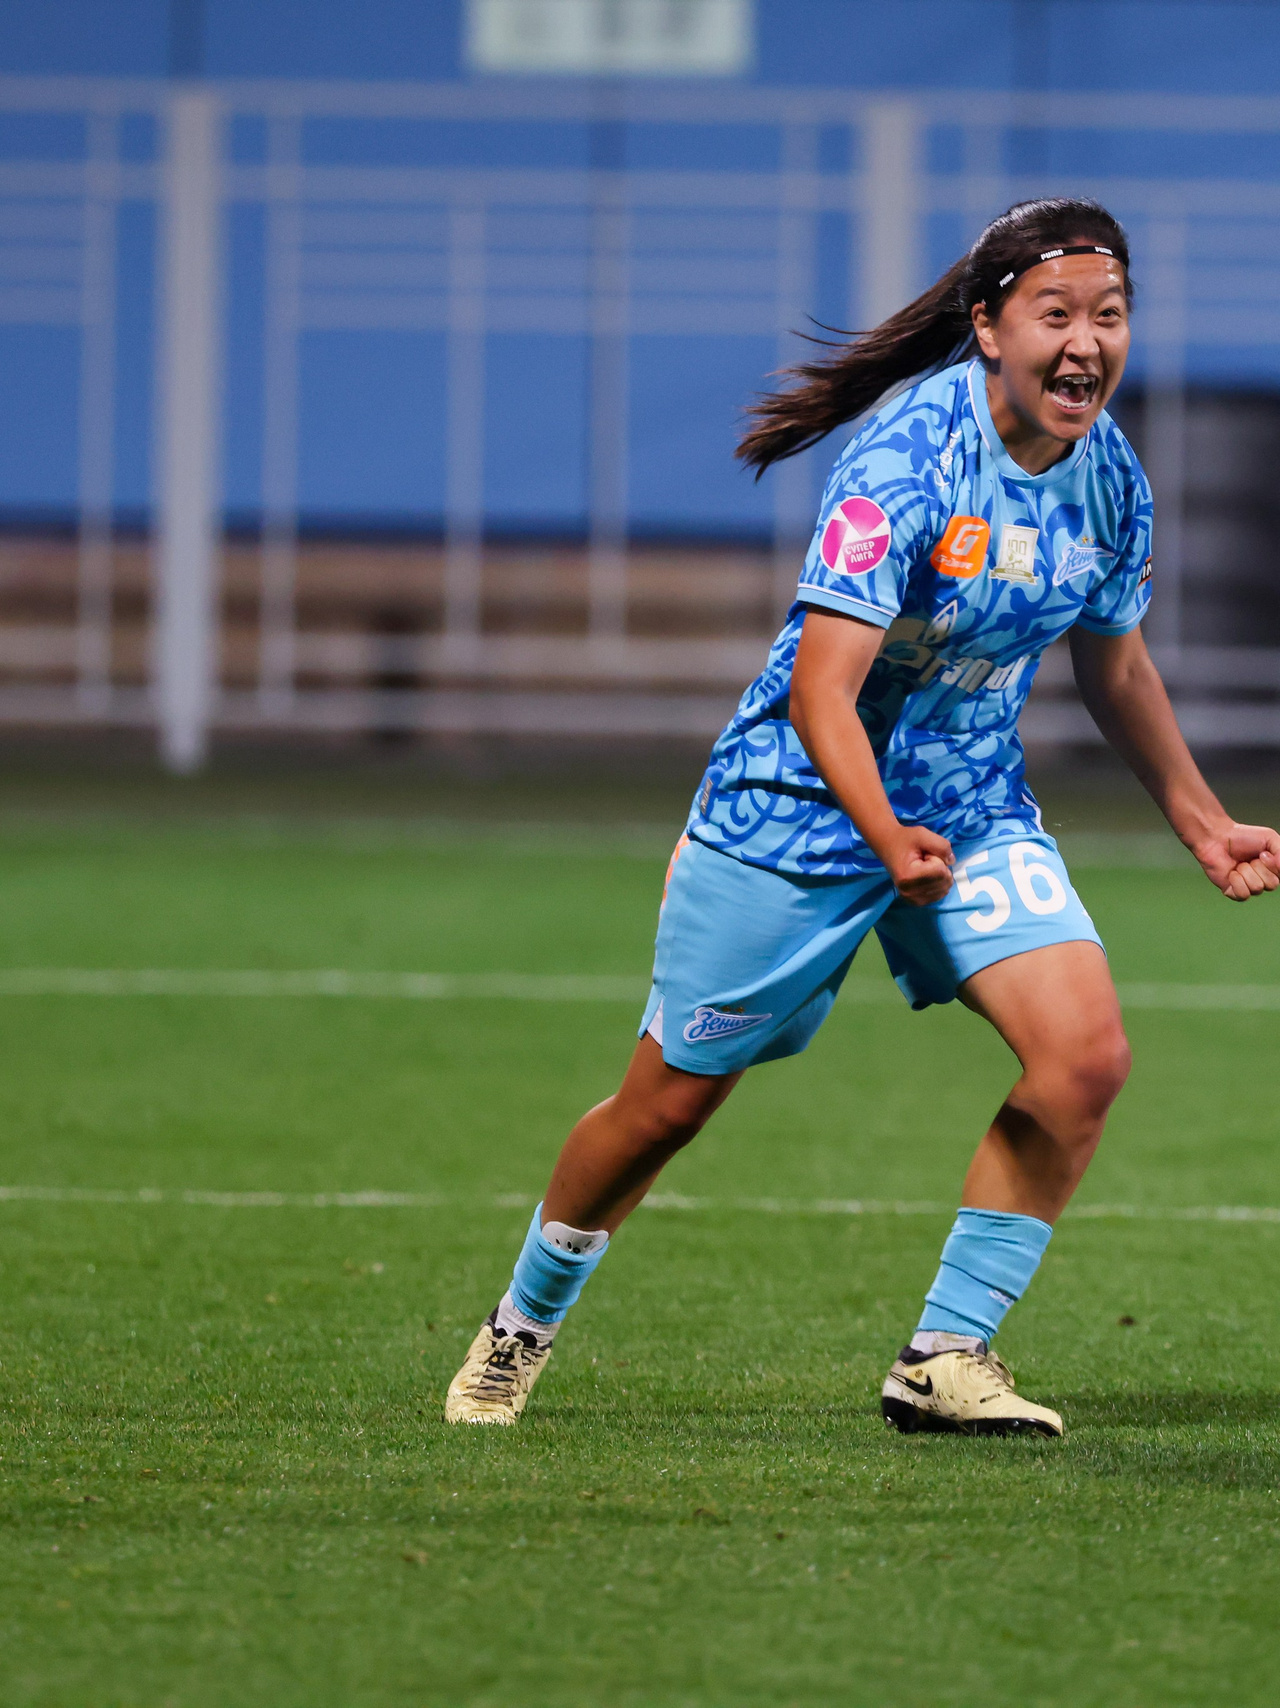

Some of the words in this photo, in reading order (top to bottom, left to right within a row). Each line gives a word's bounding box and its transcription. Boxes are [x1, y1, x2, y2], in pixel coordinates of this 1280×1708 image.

[1040, 248, 1064, 261] PUMA
[844, 540, 875, 555] СУПЕР
[850, 550, 875, 564] ЛИГА
[952, 841, 1067, 933] 56
